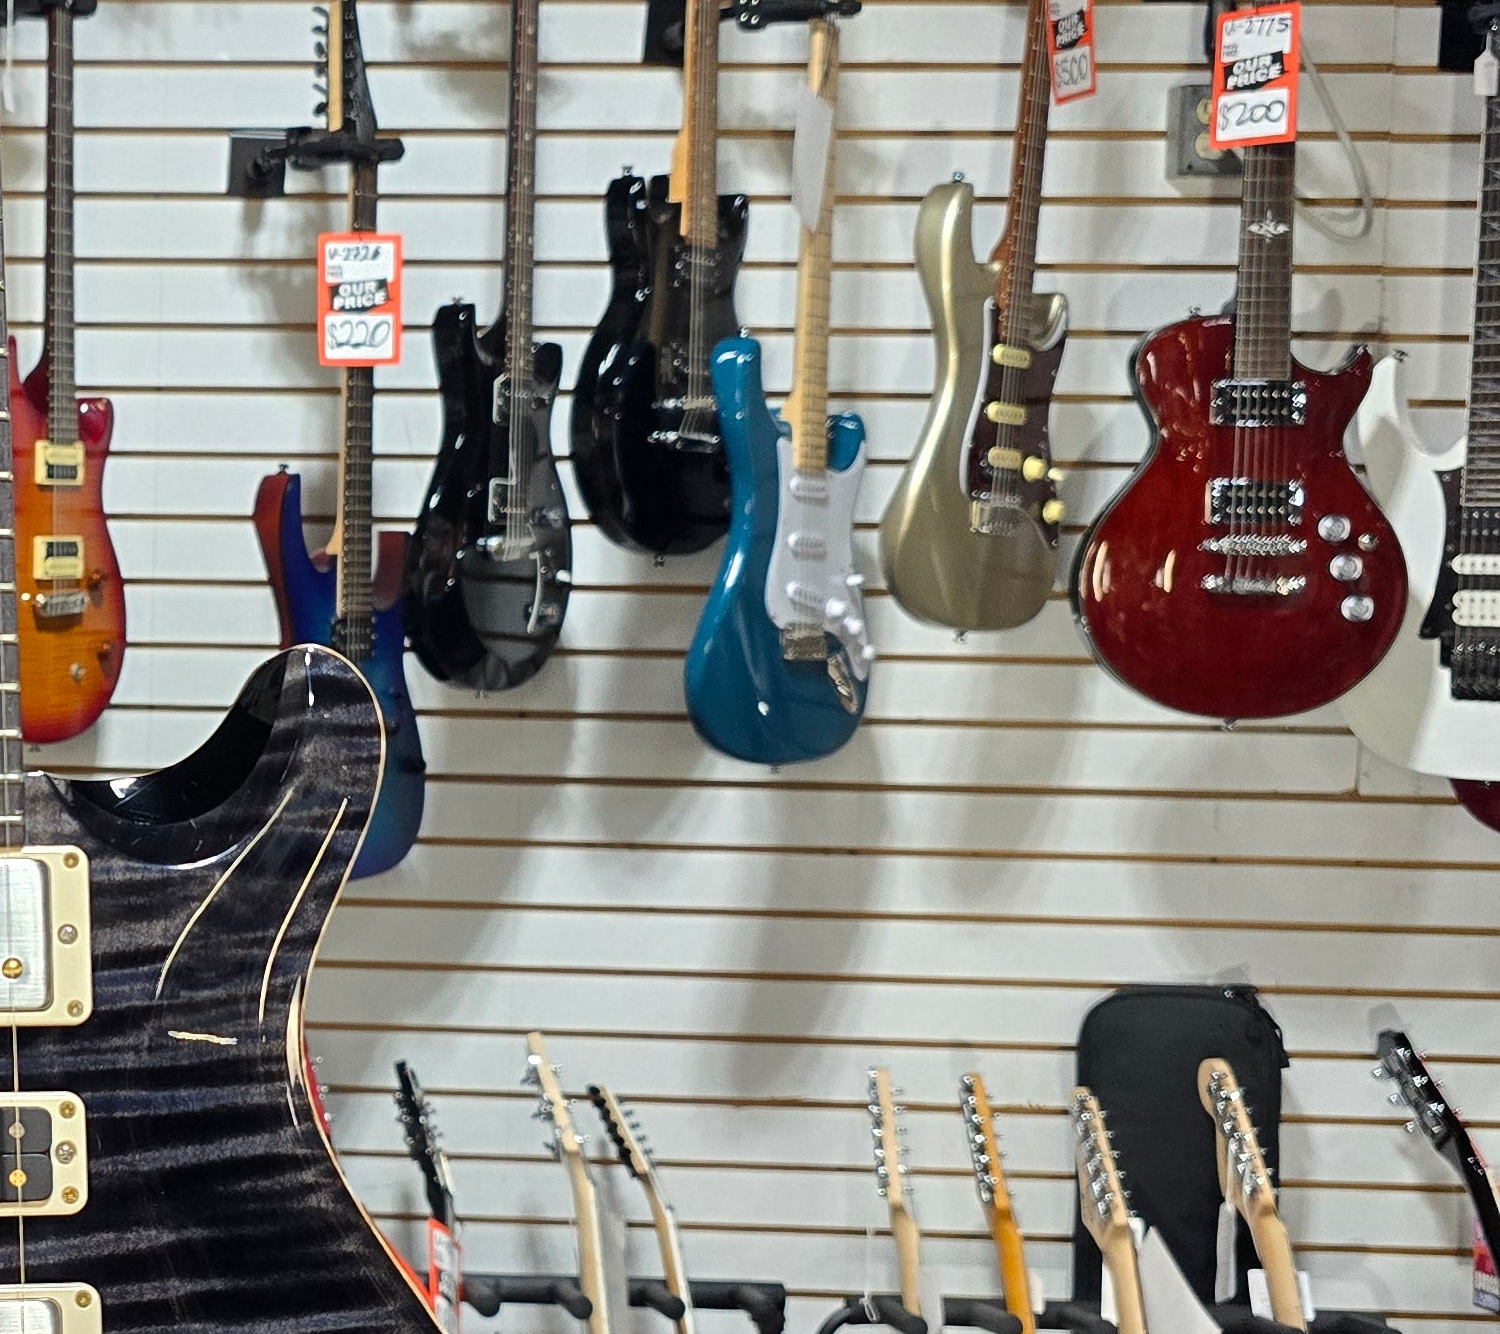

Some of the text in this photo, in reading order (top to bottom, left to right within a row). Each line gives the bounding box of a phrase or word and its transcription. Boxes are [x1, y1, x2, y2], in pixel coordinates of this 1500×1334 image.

[1232, 54, 1273, 75] OUR
[1226, 65, 1283, 90] PRICE
[1218, 100, 1286, 131] $200
[338, 282, 378, 297] OUR
[332, 292, 387, 311] PRICE
[327, 320, 391, 351] $220
